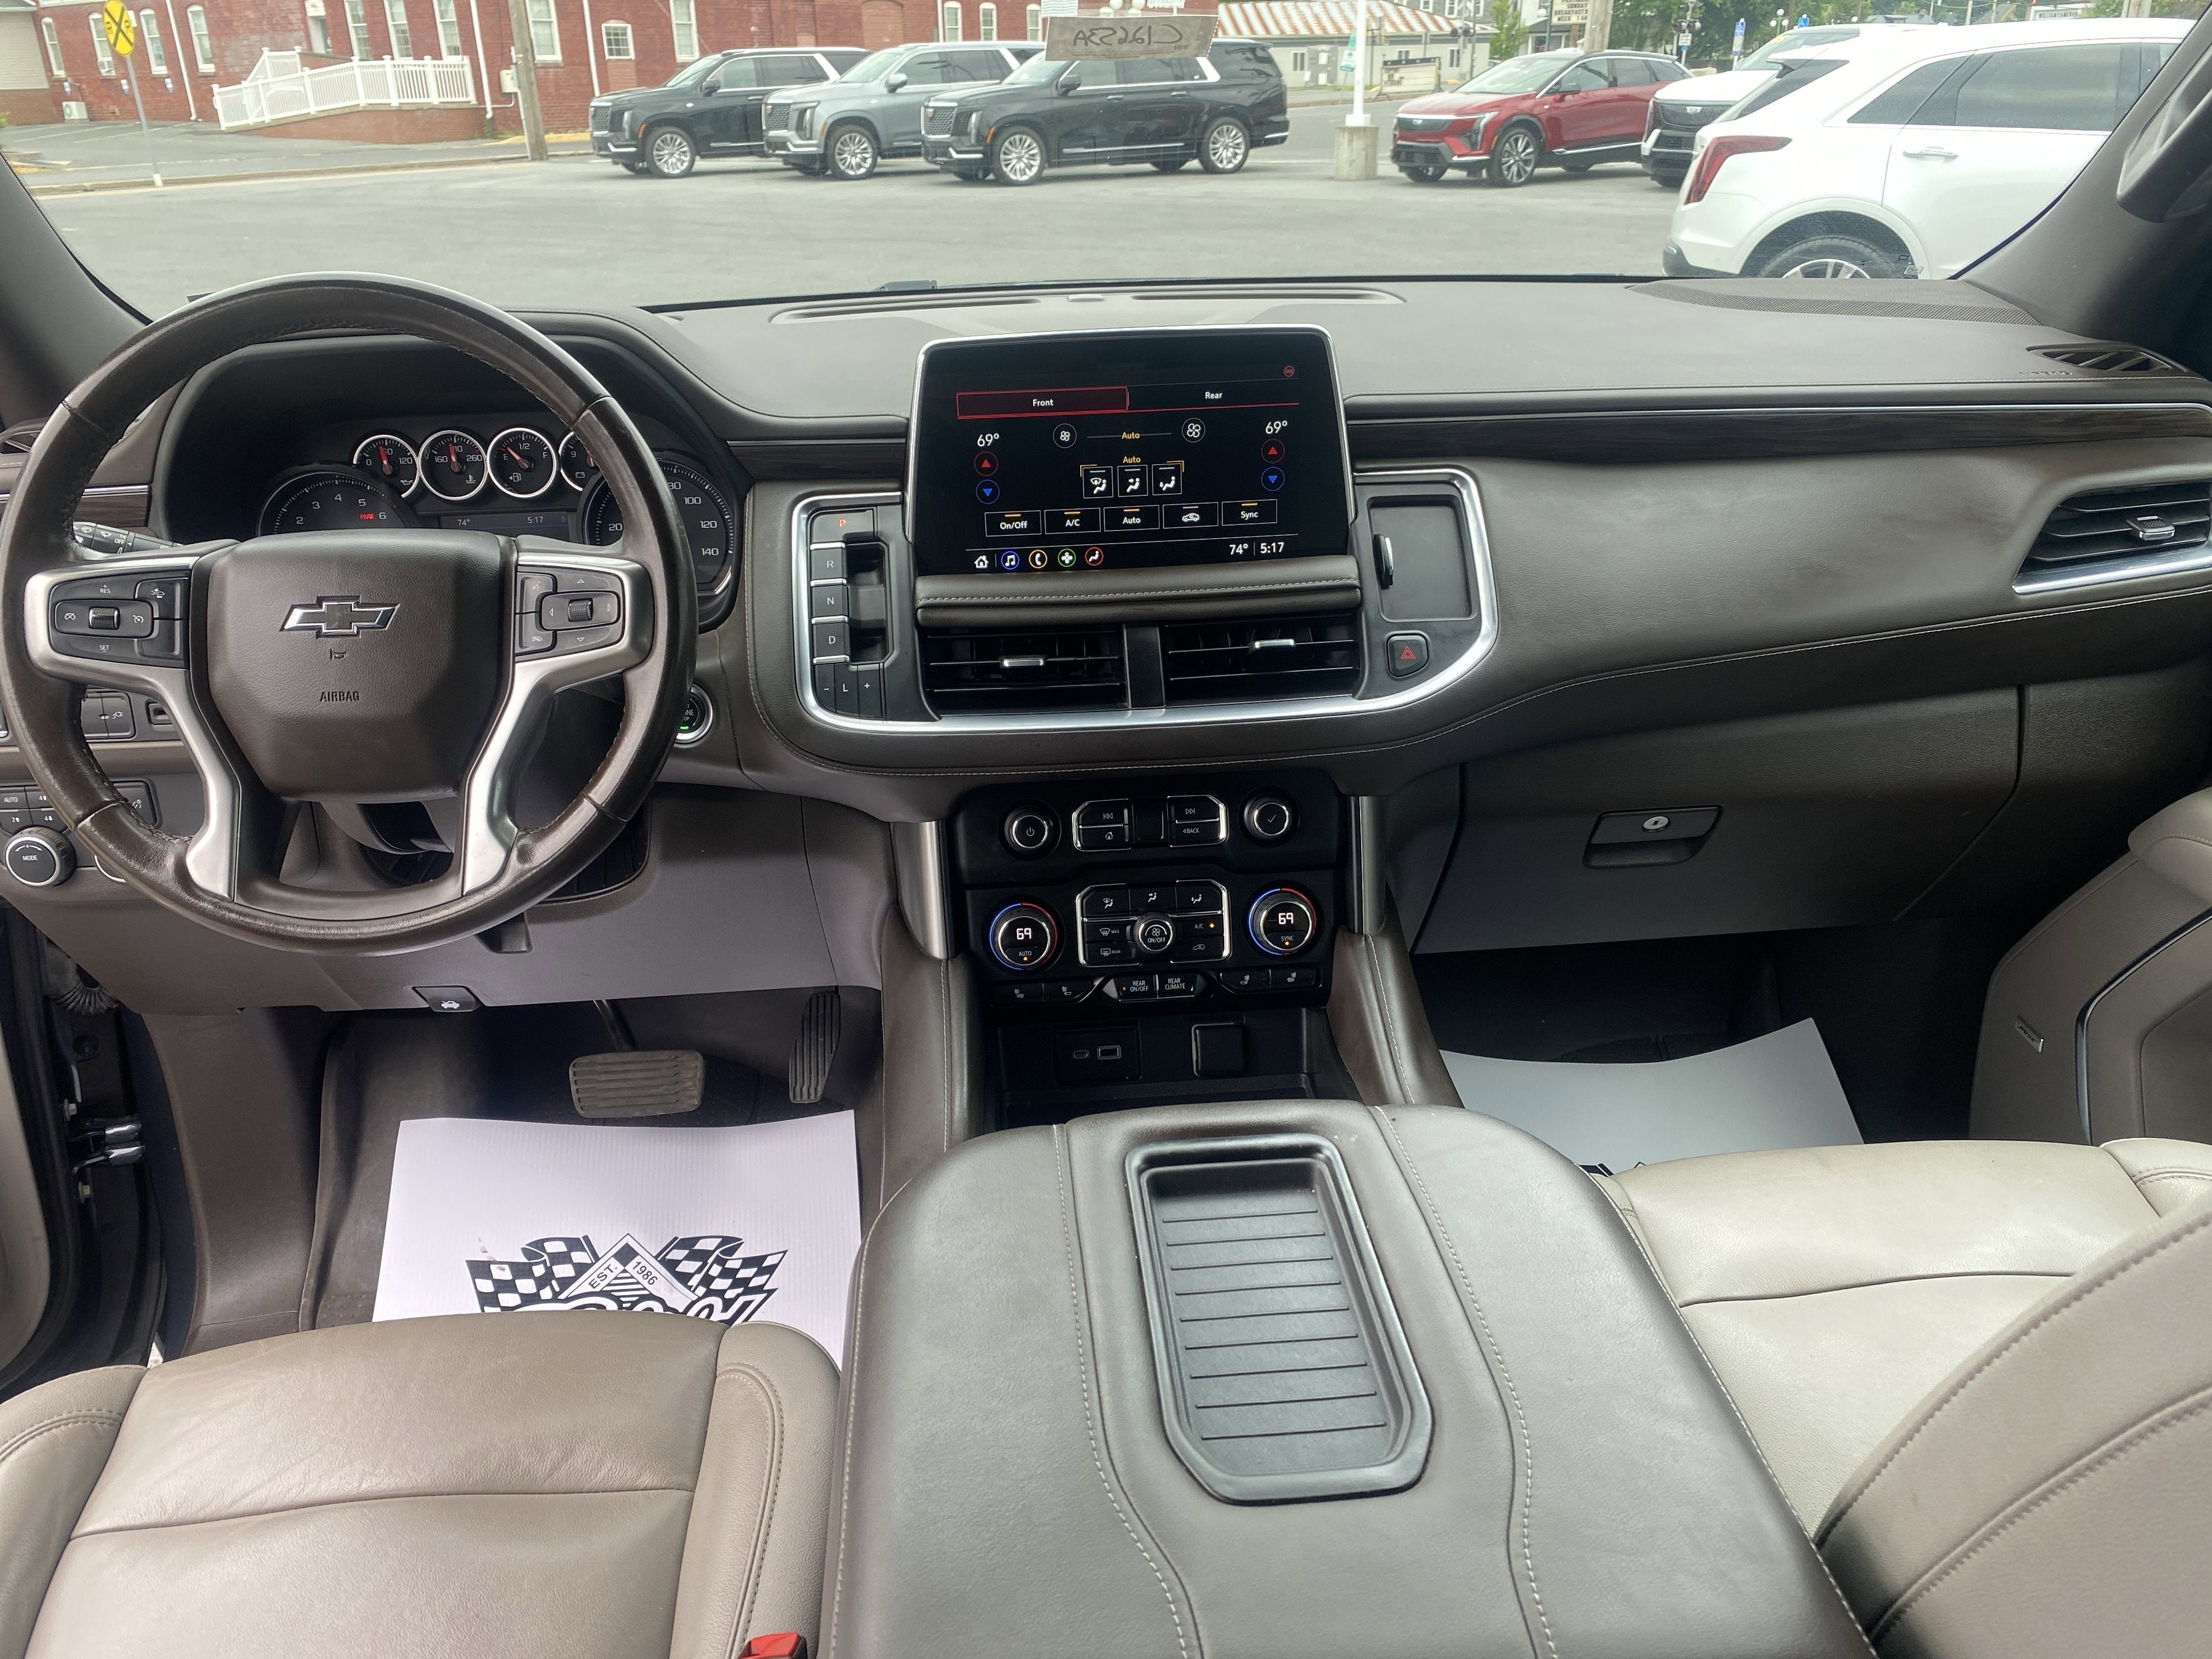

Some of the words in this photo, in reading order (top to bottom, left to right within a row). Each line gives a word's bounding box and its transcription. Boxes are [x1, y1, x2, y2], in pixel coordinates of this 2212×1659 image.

[1121, 431, 1140, 439] Auto
[398, 456, 413, 465] 120
[358, 499, 366, 507] 5
[684, 496, 702, 505] 100
[312, 501, 320, 510] 3
[527, 516, 544, 524] 5:17
[1240, 511, 1259, 520] Sync
[608, 523, 623, 531] 20
[839, 519, 846, 527] P
[1000, 521, 1028, 529] On/Off
[1065, 519, 1080, 527] A/C
[1260, 542, 1284, 554] 5:17
[829, 636, 836, 645] D
[843, 683, 849, 692] L
[320, 691, 360, 702] AIRBAG
[1278, 912, 1294, 924] 69
[1016, 928, 1031, 940] 69
[588, 1264, 618, 1289] EST.
[632, 1261, 658, 1285] 1986
